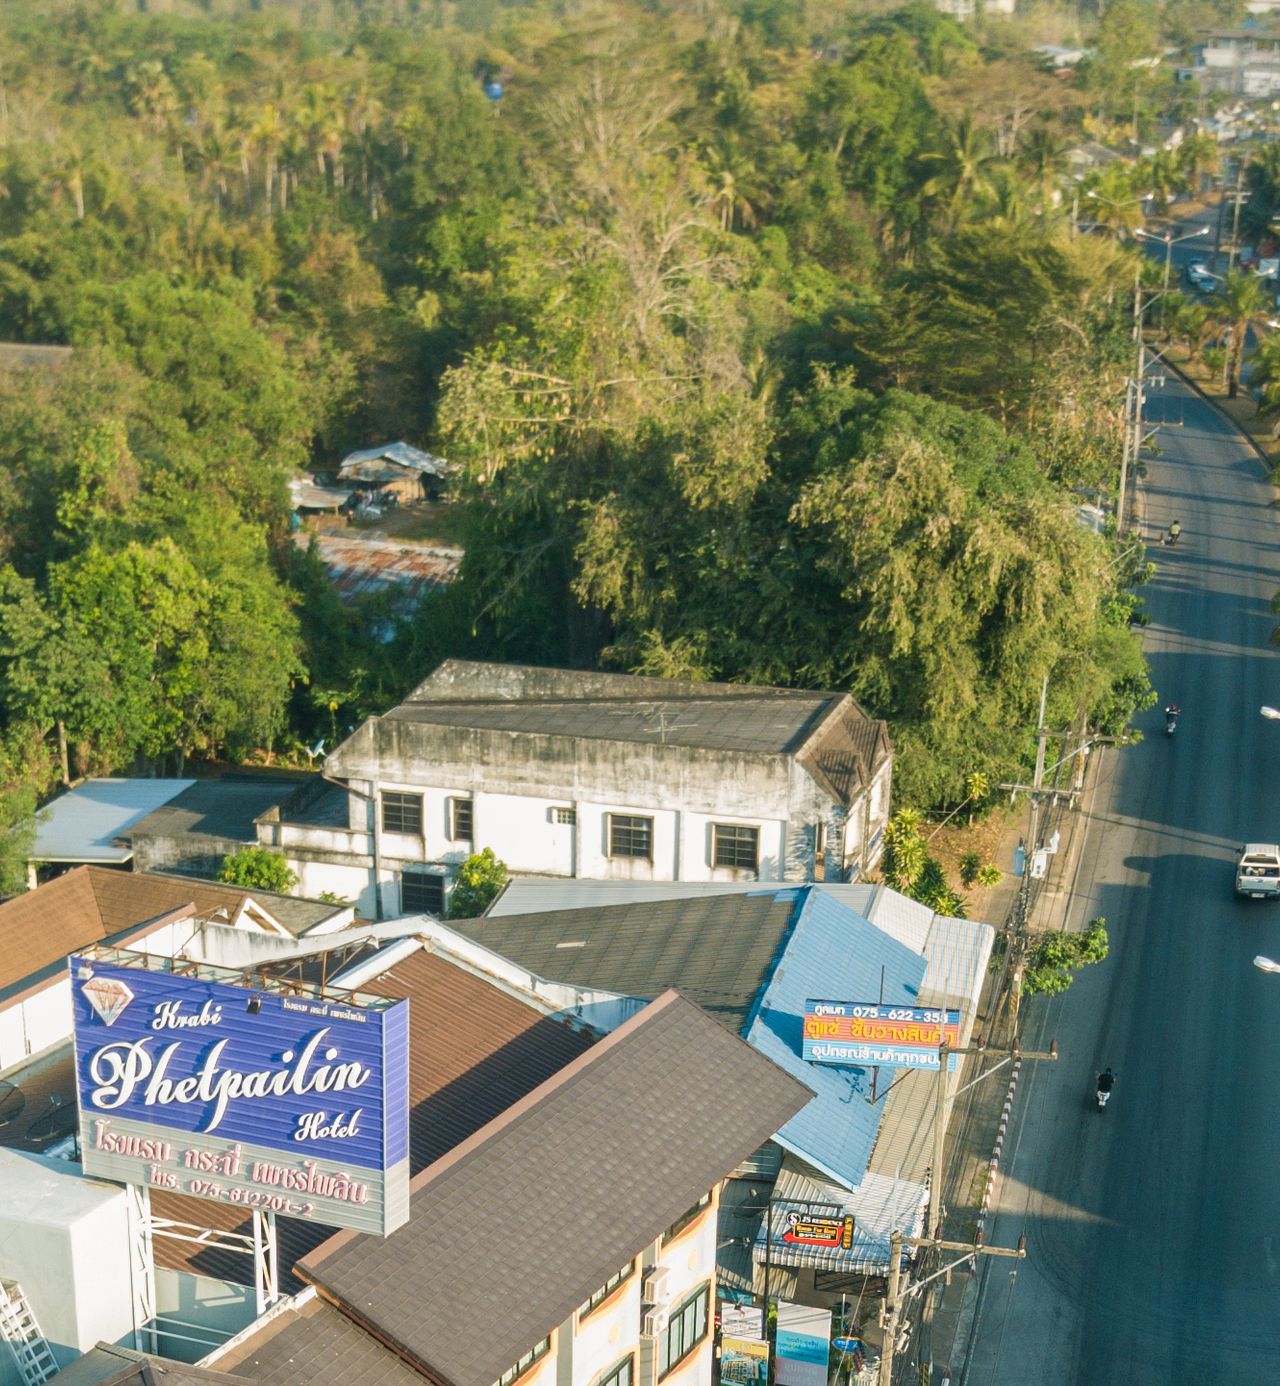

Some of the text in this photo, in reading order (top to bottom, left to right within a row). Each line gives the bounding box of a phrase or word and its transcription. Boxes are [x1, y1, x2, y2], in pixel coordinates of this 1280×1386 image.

[152, 999, 222, 1030] Krabi
[90, 1027, 371, 1133] Phetpailin
[294, 1108, 364, 1141] Hotel
[94, 1119, 368, 1204] โรงแรม กระบี่ เพชรไพลิน
[148, 1163, 181, 1189] โทร.
